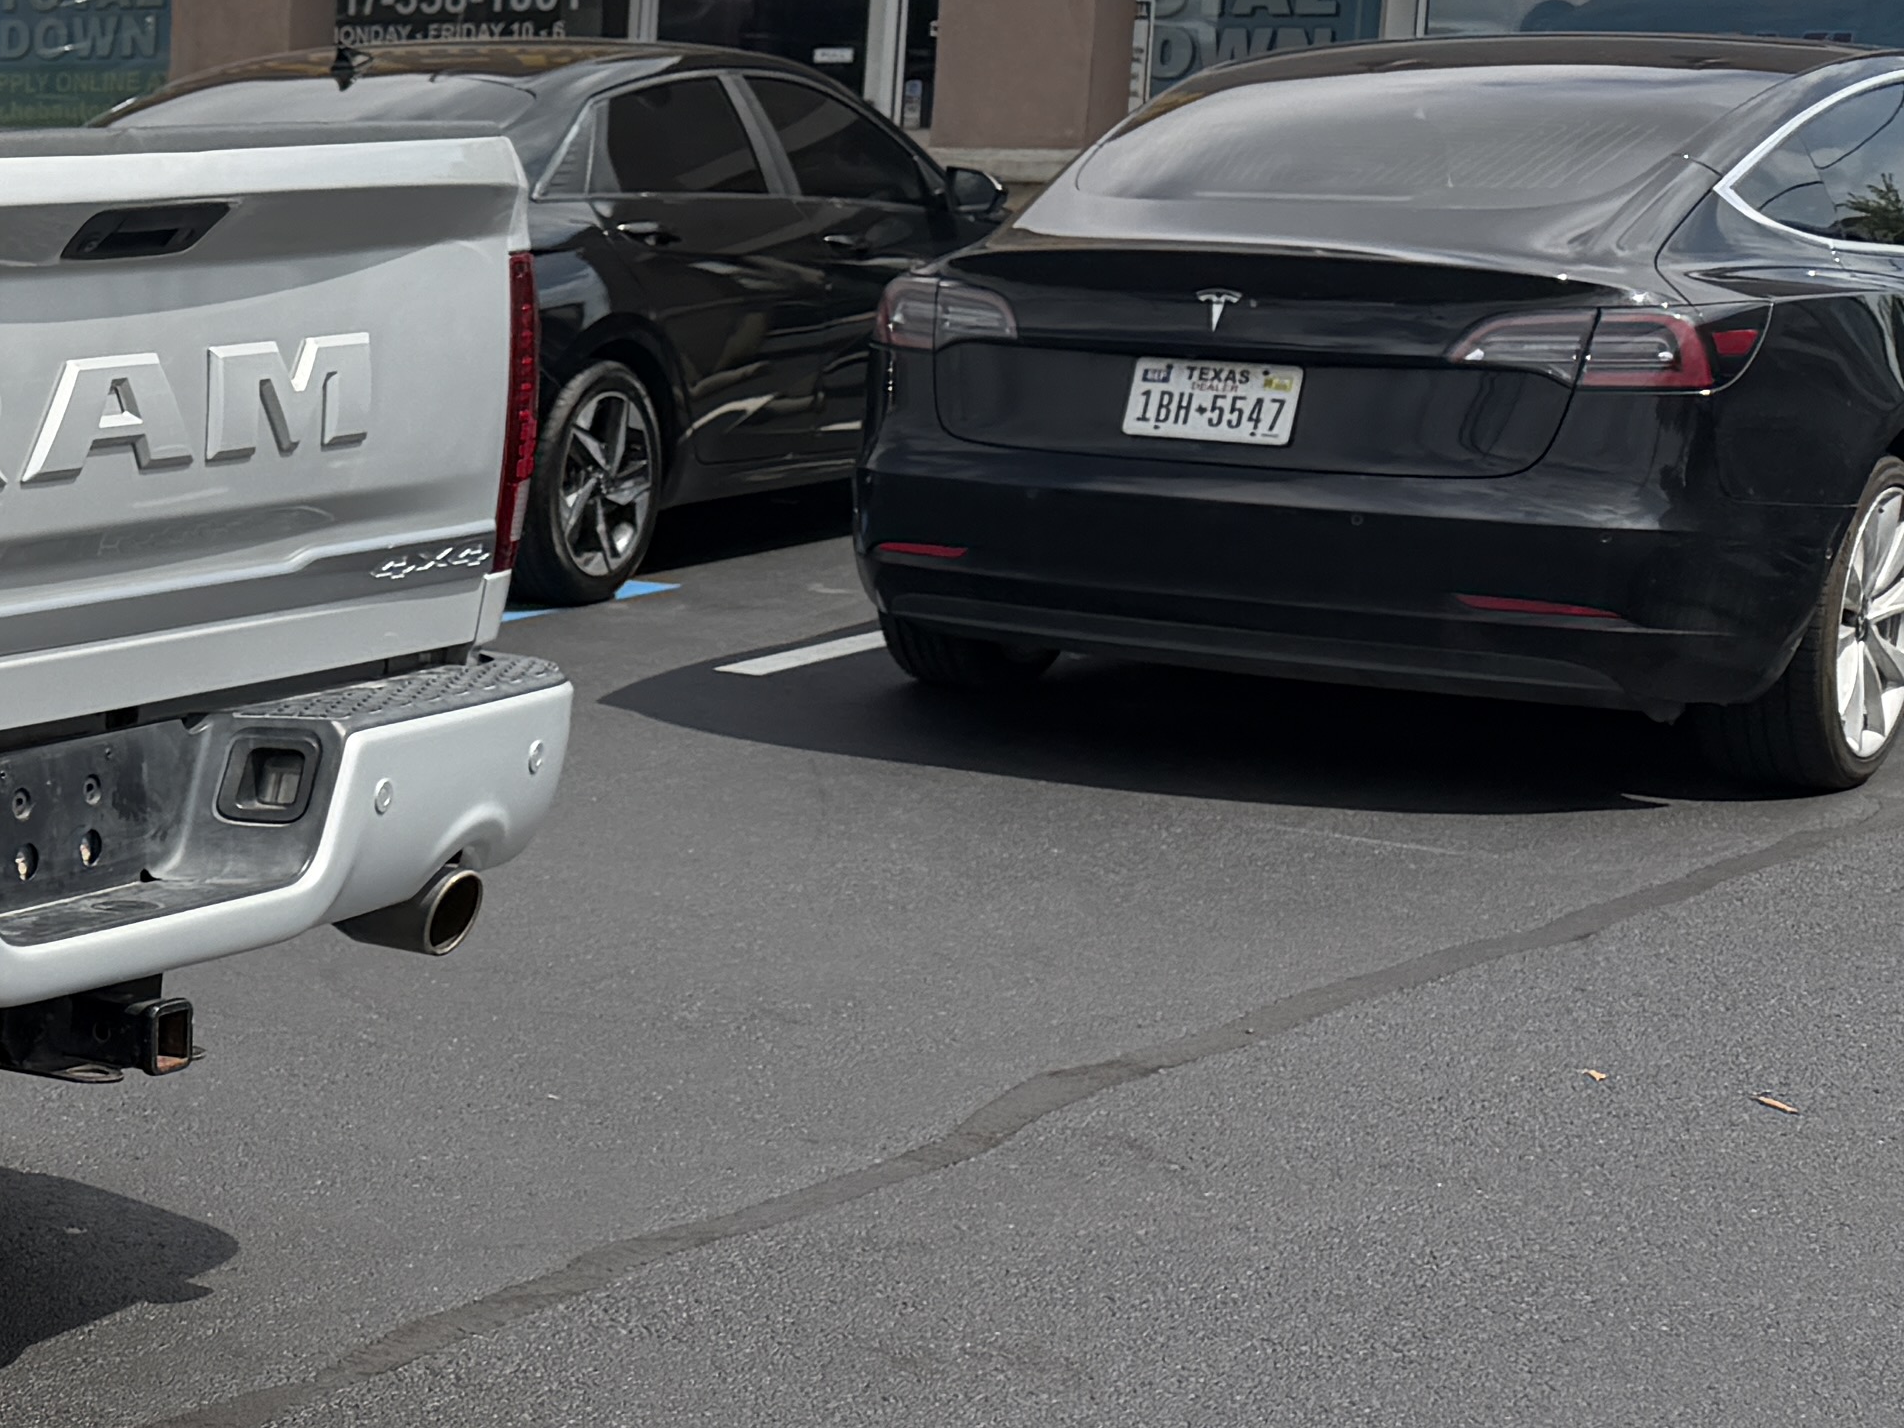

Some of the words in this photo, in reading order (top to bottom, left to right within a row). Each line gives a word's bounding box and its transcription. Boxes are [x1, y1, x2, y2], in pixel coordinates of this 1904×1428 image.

[335, 24, 412, 47] ONDAY
[428, 22, 505, 41] FRIDAY
[55, 70, 141, 93] ONLINE
[1186, 365, 1250, 385] TEXAS
[1191, 382, 1239, 394] DEALER
